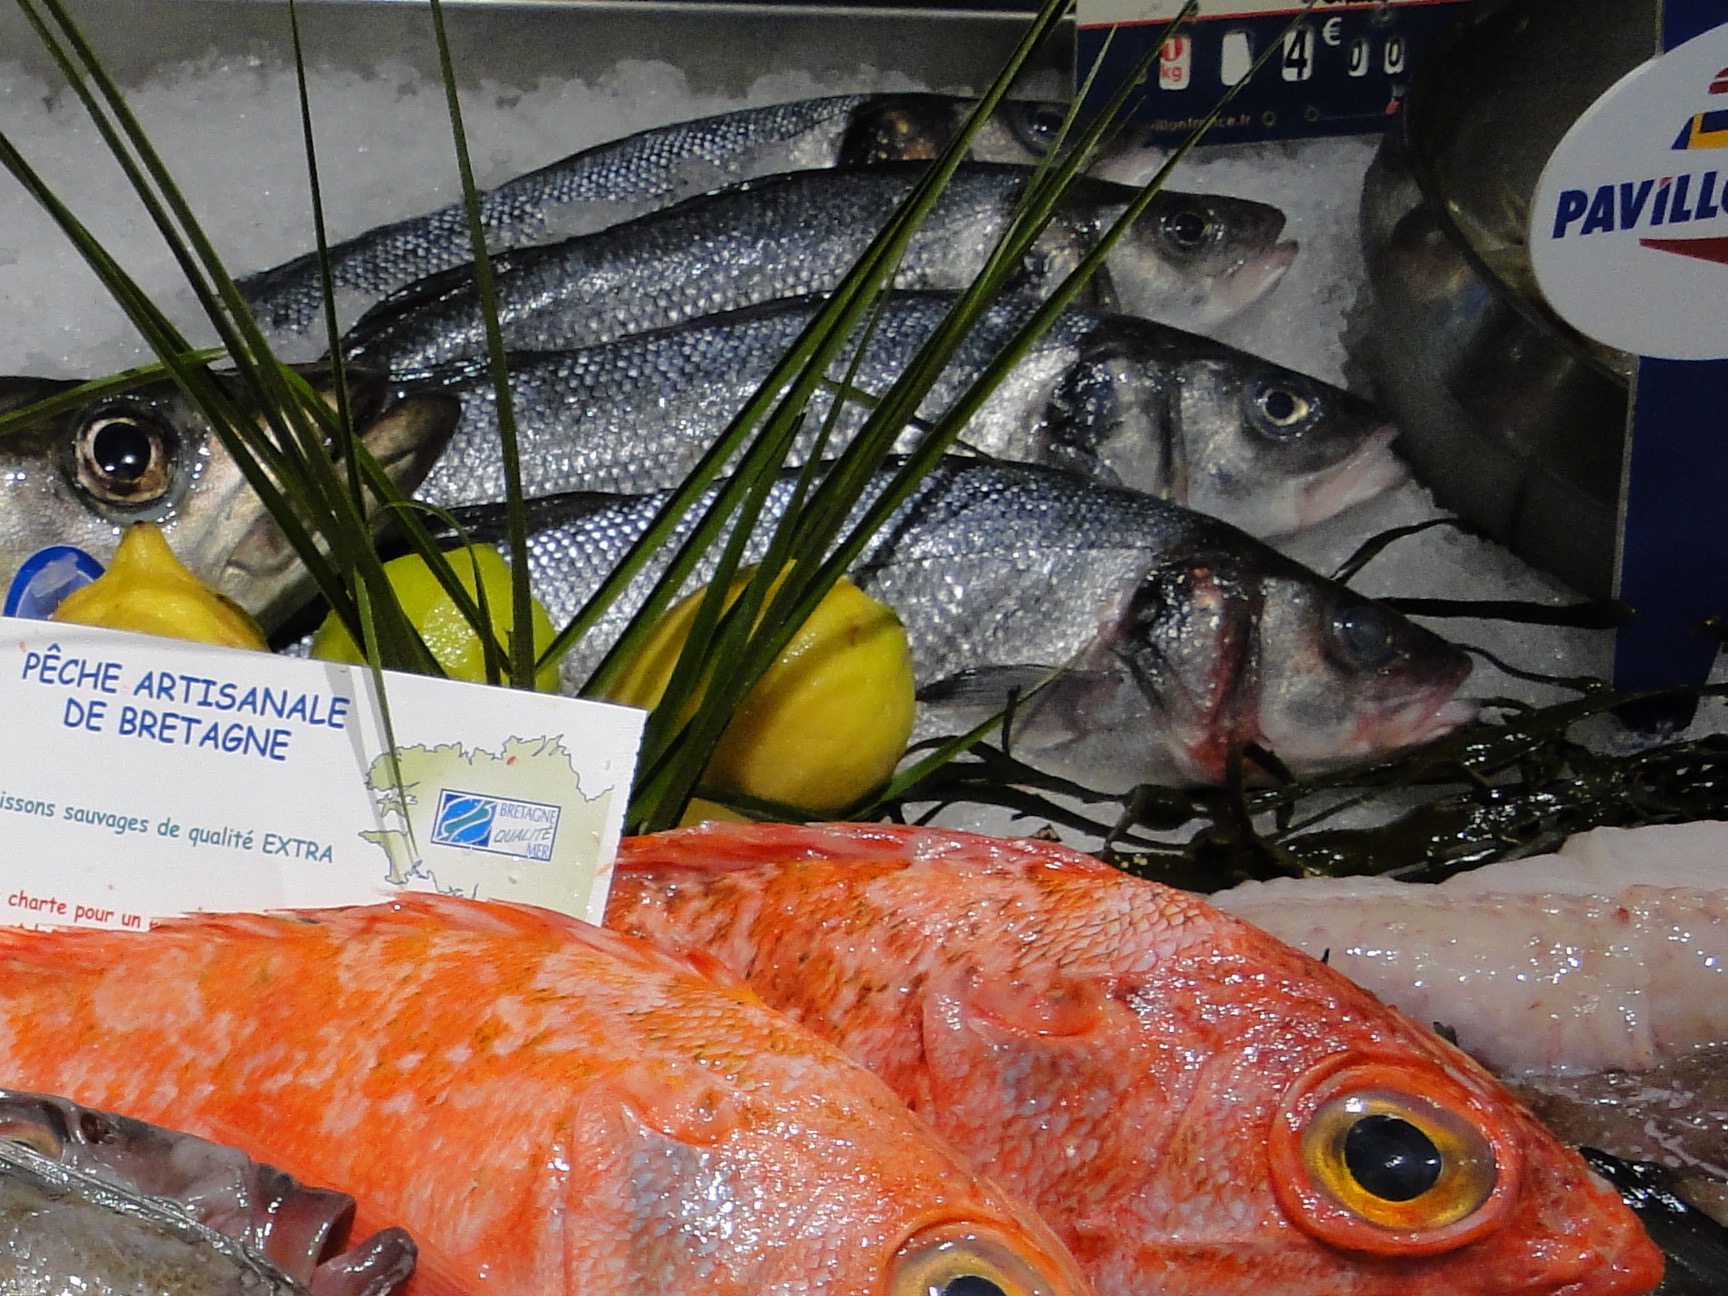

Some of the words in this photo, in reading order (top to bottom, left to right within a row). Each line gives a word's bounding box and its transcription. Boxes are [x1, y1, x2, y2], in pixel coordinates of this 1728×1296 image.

[1551, 170, 1728, 240] PAVILL
[22, 642, 123, 694] PÊCHE
[133, 670, 351, 730] ARTISANALE
[63, 697, 107, 732] DE
[118, 705, 293, 762] BRETAGNE
[63, 804, 149, 836] sauvages
[157, 816, 180, 839] de
[188, 826, 255, 849] qualité
[261, 832, 334, 865] EXTRA
[493, 824, 554, 844] QUALITÉ
[499, 802, 557, 824] BRETAGNE
[524, 843, 552, 860] MER
[8, 889, 69, 916] charte
[73, 903, 115, 923] pour
[121, 912, 142, 929] un
